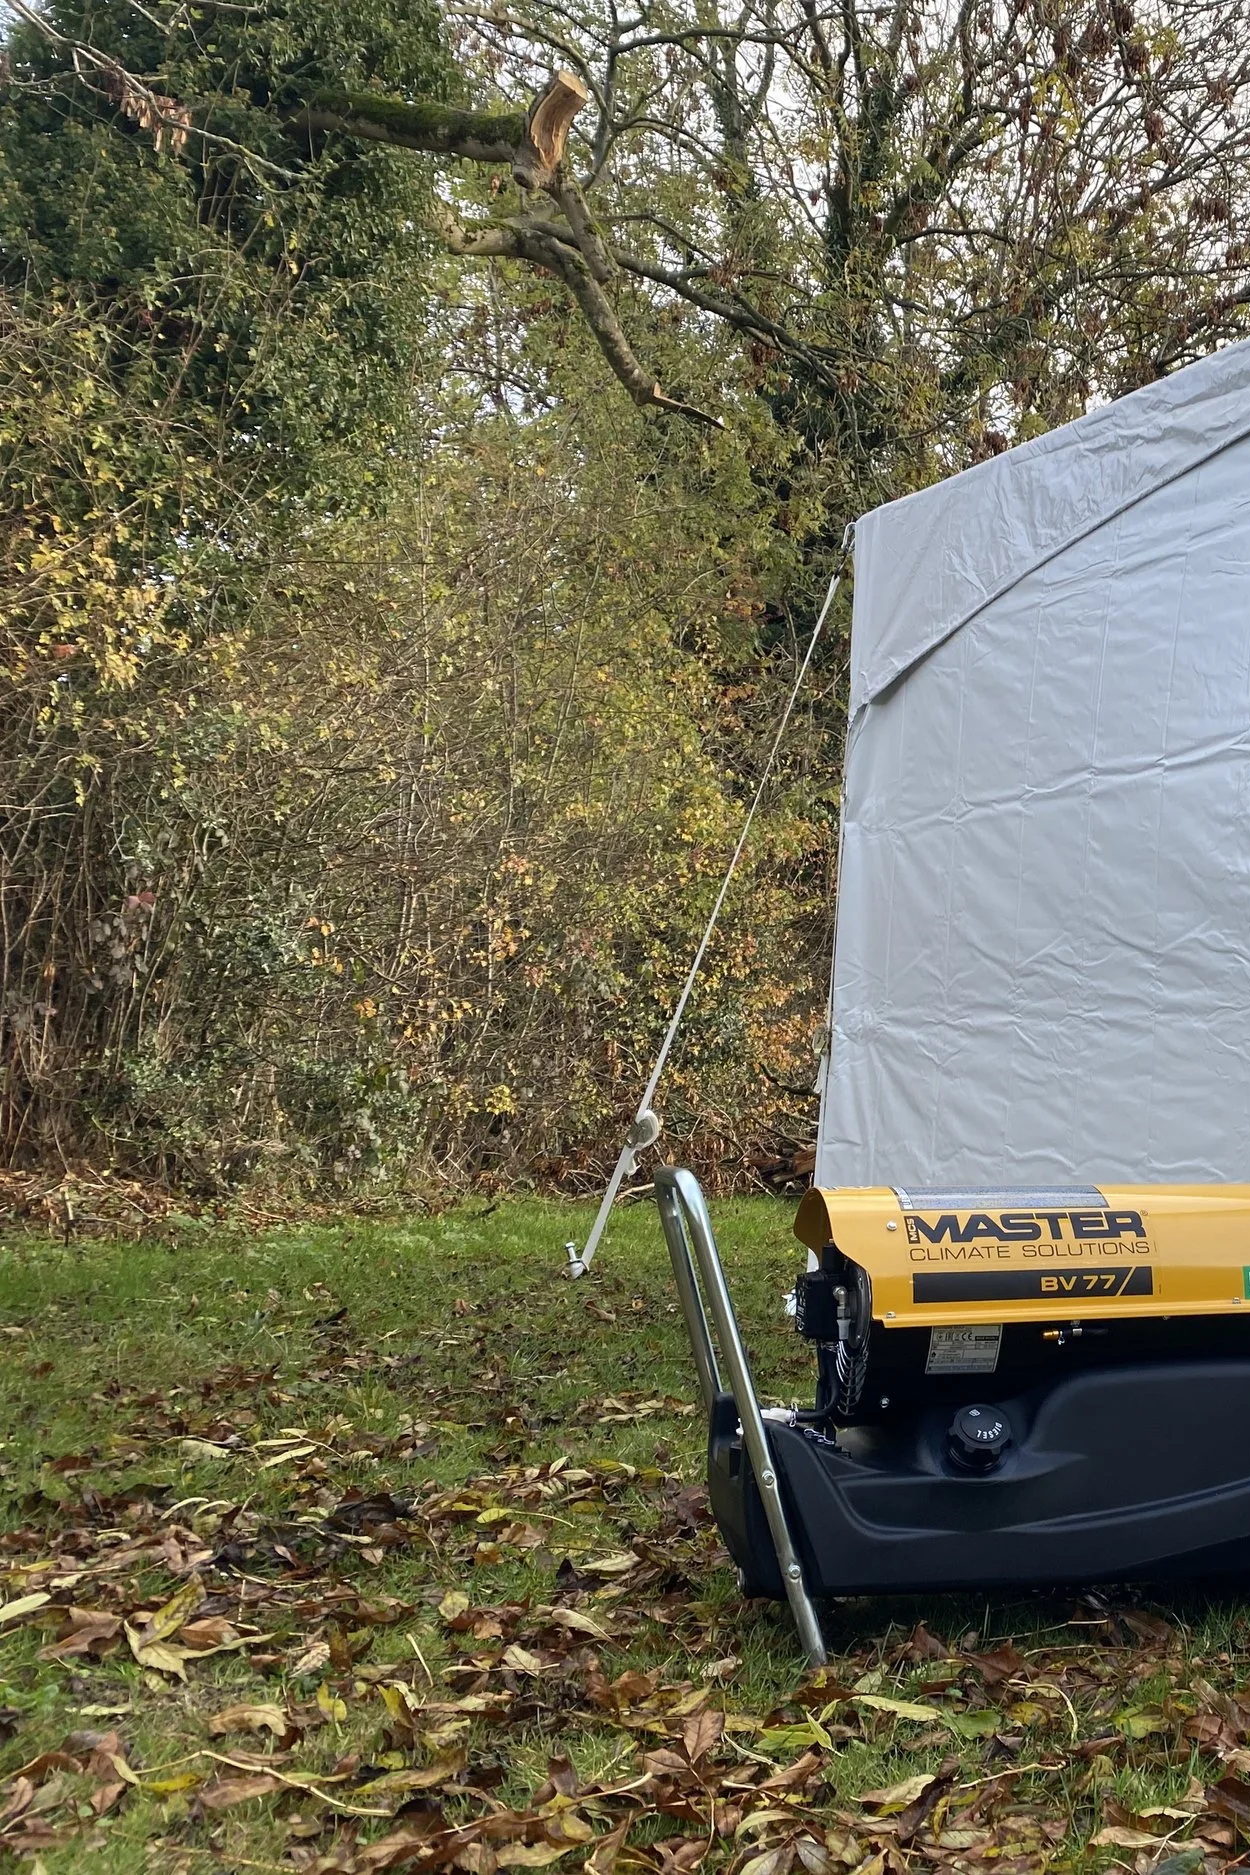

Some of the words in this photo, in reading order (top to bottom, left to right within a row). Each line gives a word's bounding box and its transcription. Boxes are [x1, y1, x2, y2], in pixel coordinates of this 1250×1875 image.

[906, 1218, 918, 1241] MCS
[914, 1210, 1147, 1244] MASTER
[909, 1245, 1011, 1262] CLIMATE
[1022, 1241, 1150, 1258] SOLUTIONS
[1040, 1275, 1078, 1292] BV
[1082, 1274, 1116, 1290] 77
[976, 1421, 1003, 1440] DIESEL
